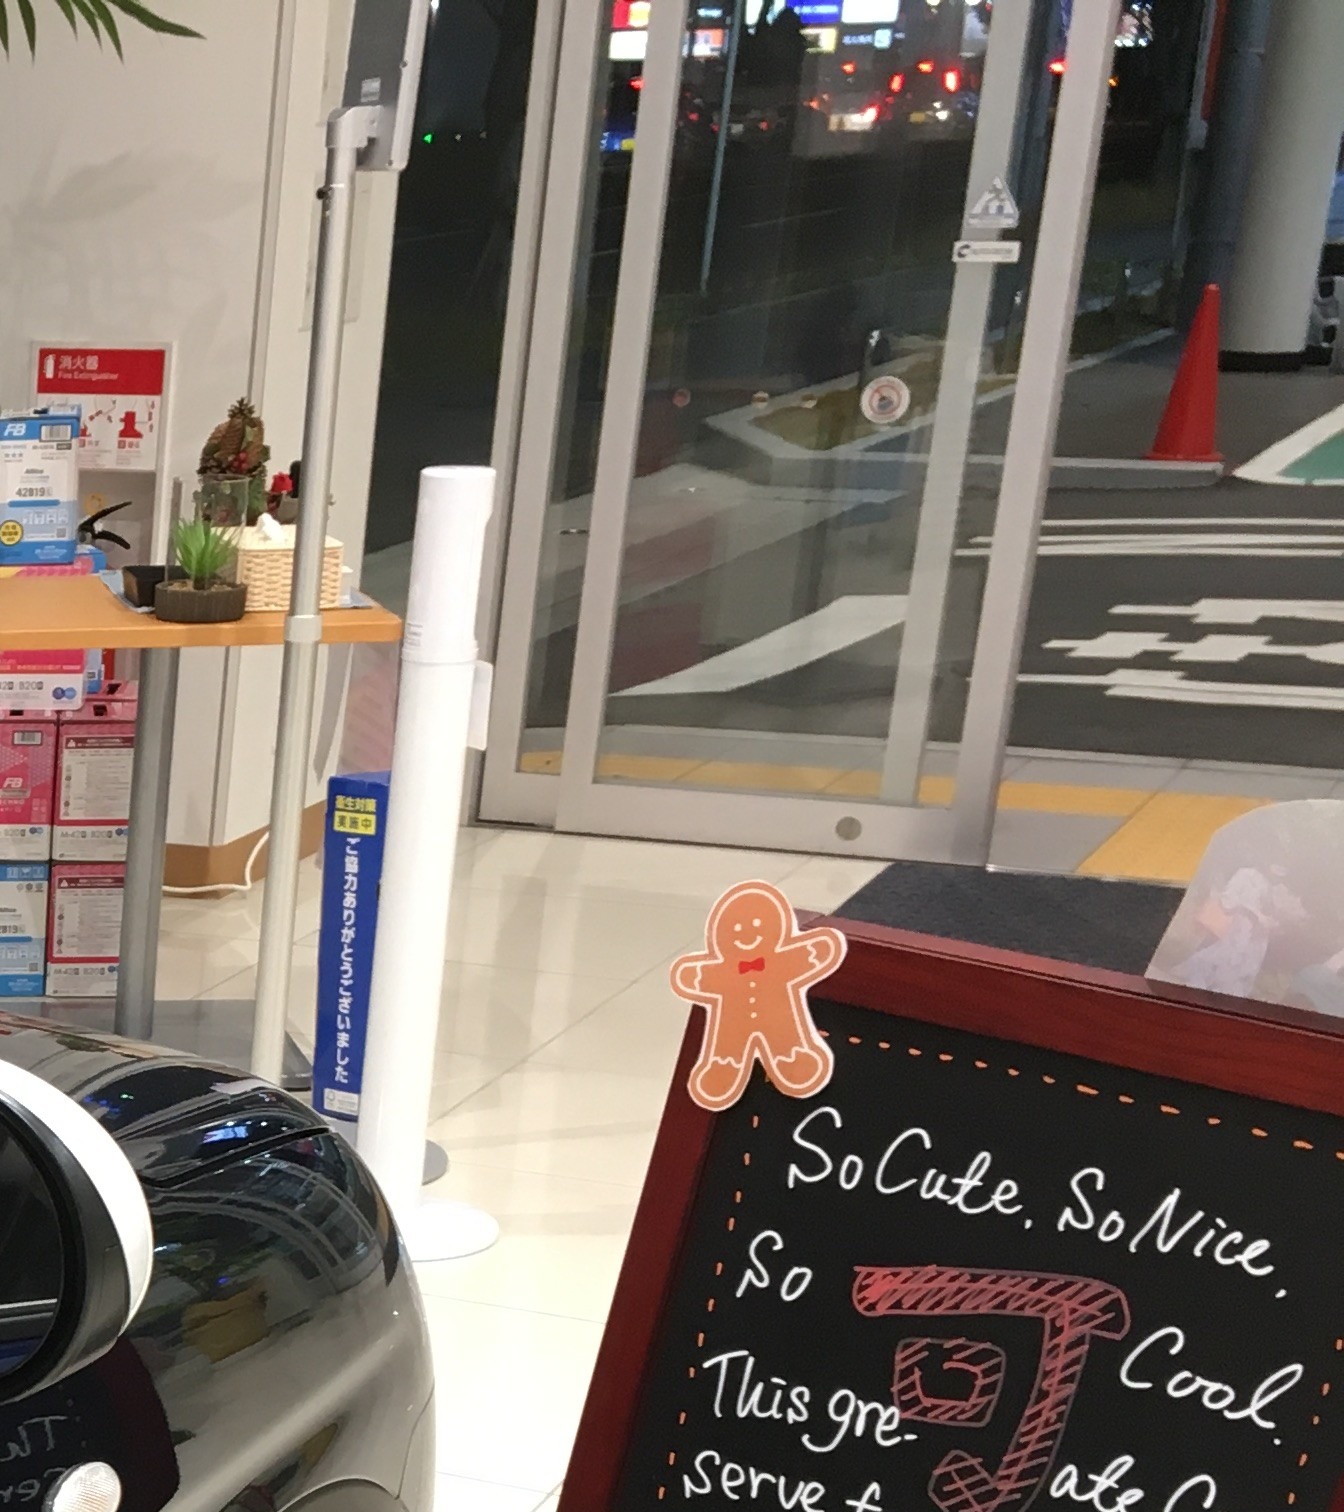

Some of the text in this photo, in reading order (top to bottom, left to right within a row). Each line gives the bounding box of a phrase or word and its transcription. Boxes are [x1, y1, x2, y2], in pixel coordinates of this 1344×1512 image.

[58, 355, 99, 370] 消火器
[4, 423, 26, 437] FB
[336, 814, 373, 831] 実施中
[334, 836, 361, 1085] ご協力ありがとうございました
[786, 1105, 865, 1191] So
[1056, 1166, 1126, 1243] So
[734, 1228, 814, 1303] So
[701, 1348, 812, 1426] This
